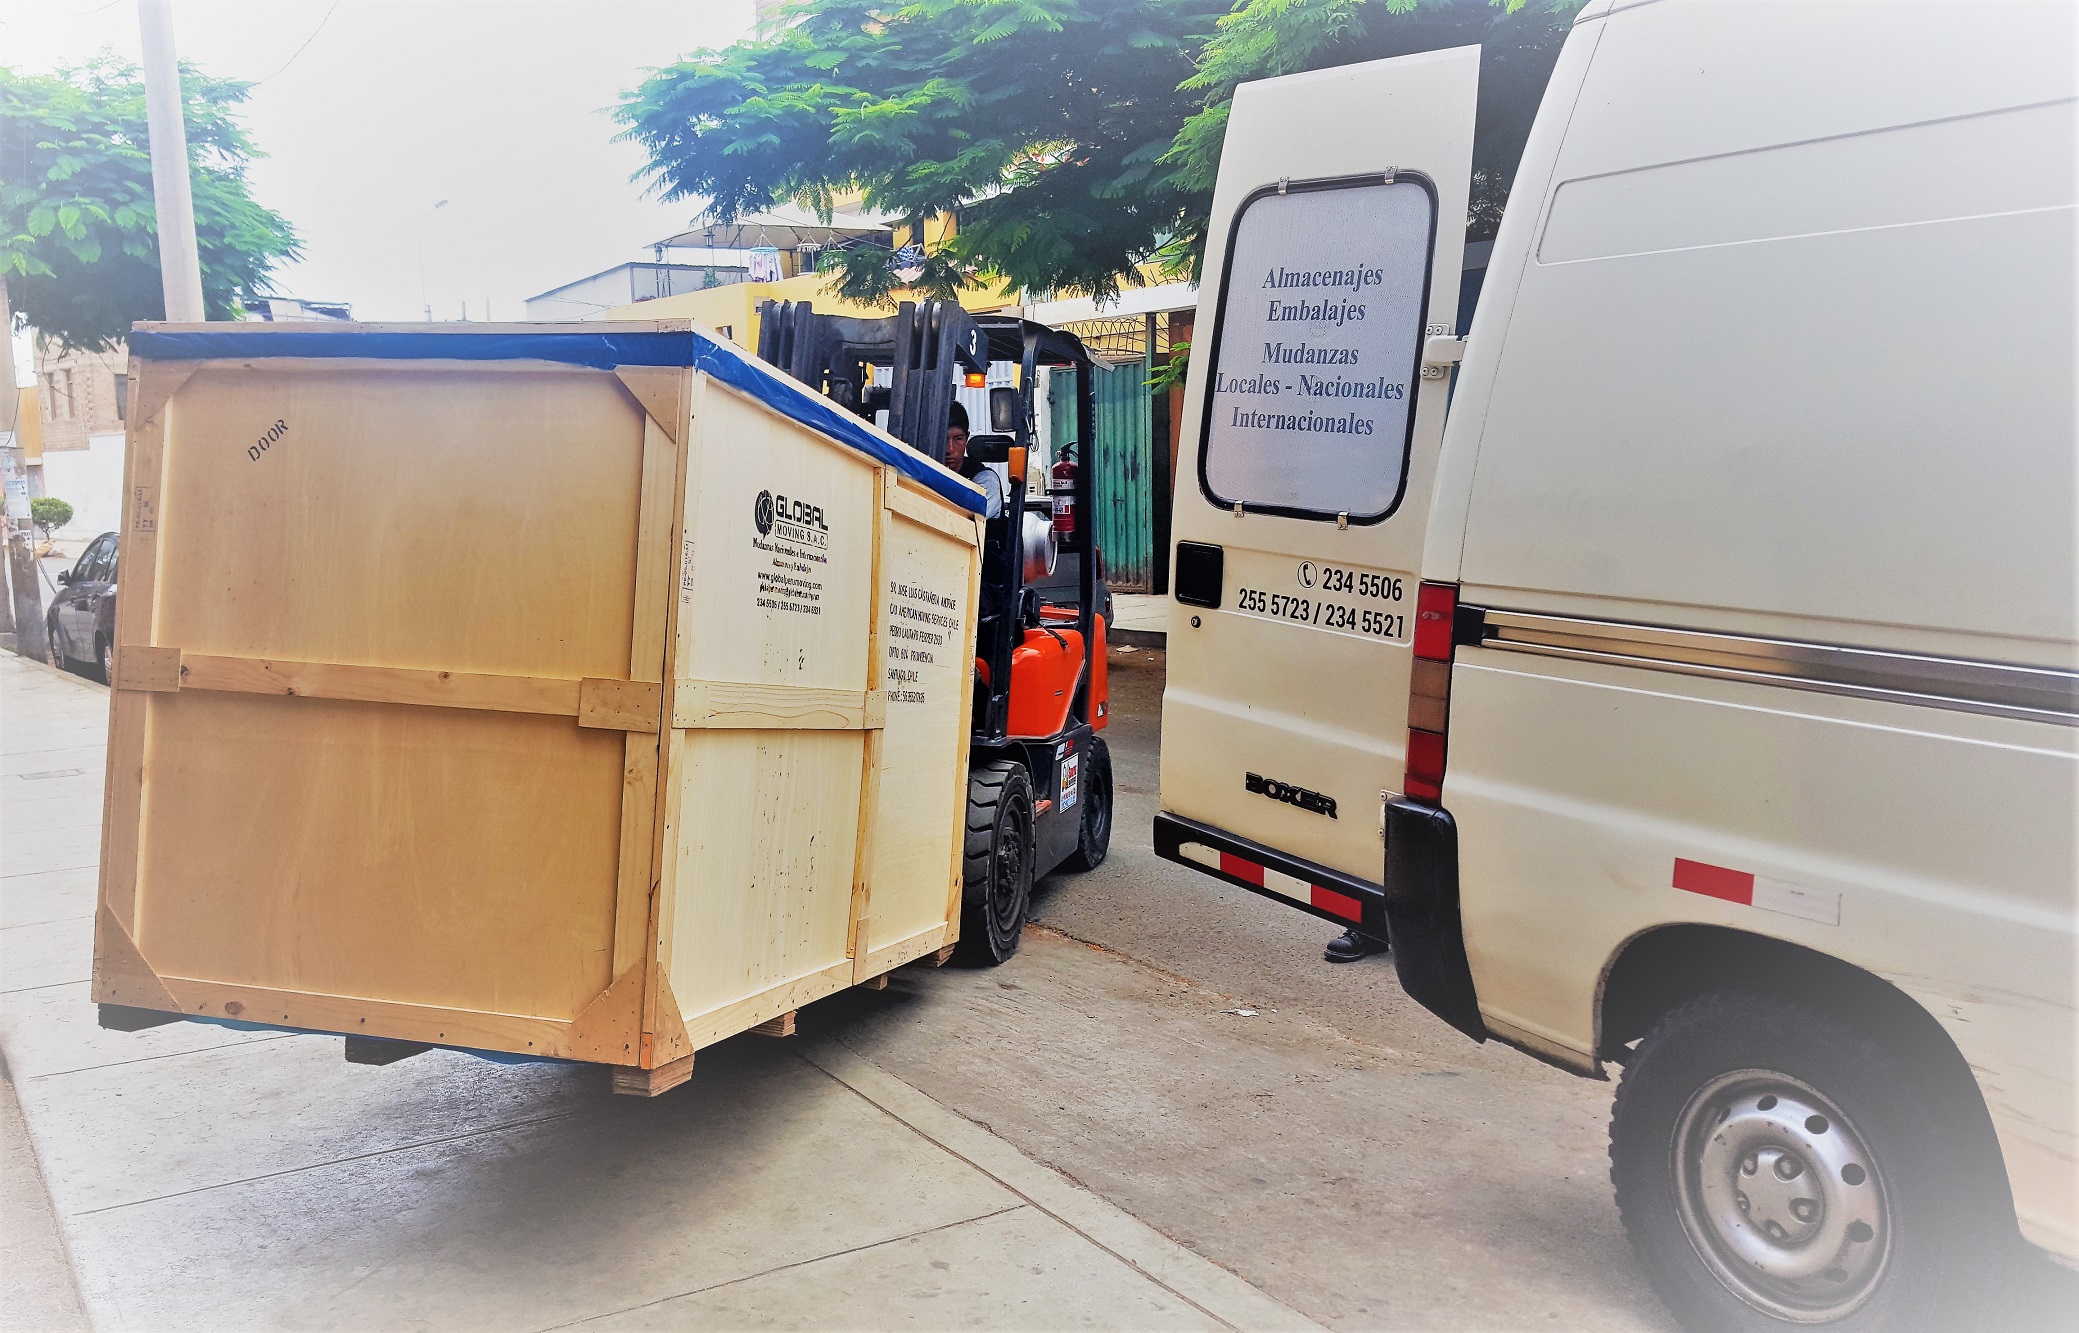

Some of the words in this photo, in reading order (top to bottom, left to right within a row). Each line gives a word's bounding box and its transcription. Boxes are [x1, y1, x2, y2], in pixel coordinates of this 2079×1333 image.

[1261, 263, 1384, 292] Almacenajes
[1266, 298, 1367, 327] Embalajes
[969, 329, 977, 356] 3
[1261, 341, 1359, 366] Mudanzas
[1214, 371, 1281, 396] Locales
[1296, 373, 1405, 401] Nacionales
[1230, 406, 1374, 436] Internacionales
[247, 419, 289, 462] DOOR
[775, 494, 829, 531] GLOBAL
[777, 523, 805, 541] MOVING
[1322, 567, 1354, 594] 234
[1358, 572, 1403, 602] 5506
[1238, 587, 1267, 613] 255
[1270, 593, 1310, 622] 5723
[1325, 603, 1357, 630] 234
[1361, 610, 1404, 639] 5521
[1245, 771, 1338, 820] BOXER
